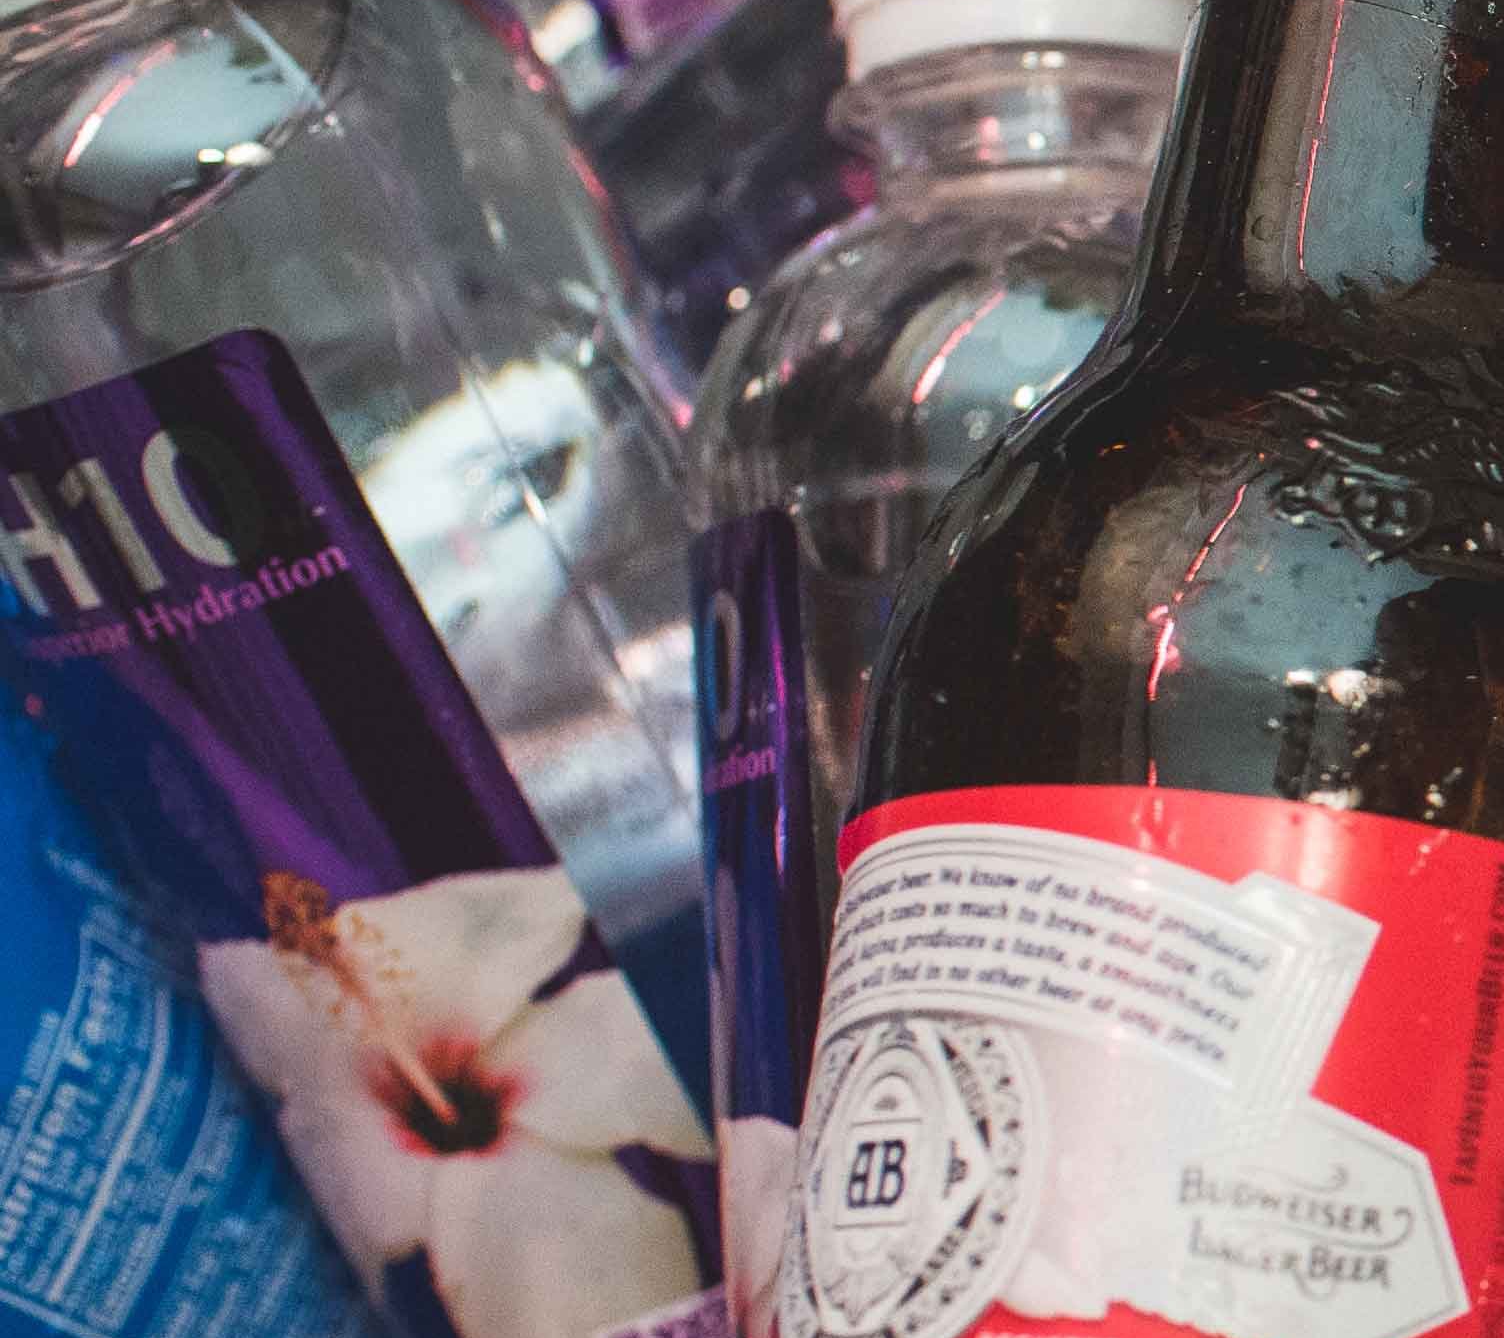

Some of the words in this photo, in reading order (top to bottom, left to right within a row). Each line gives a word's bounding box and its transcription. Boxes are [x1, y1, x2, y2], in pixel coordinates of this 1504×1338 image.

[136, 546, 350, 644] Hydration
[846, 1139, 909, 1210] AB
[1176, 1165, 1386, 1238] BUDWEISER
